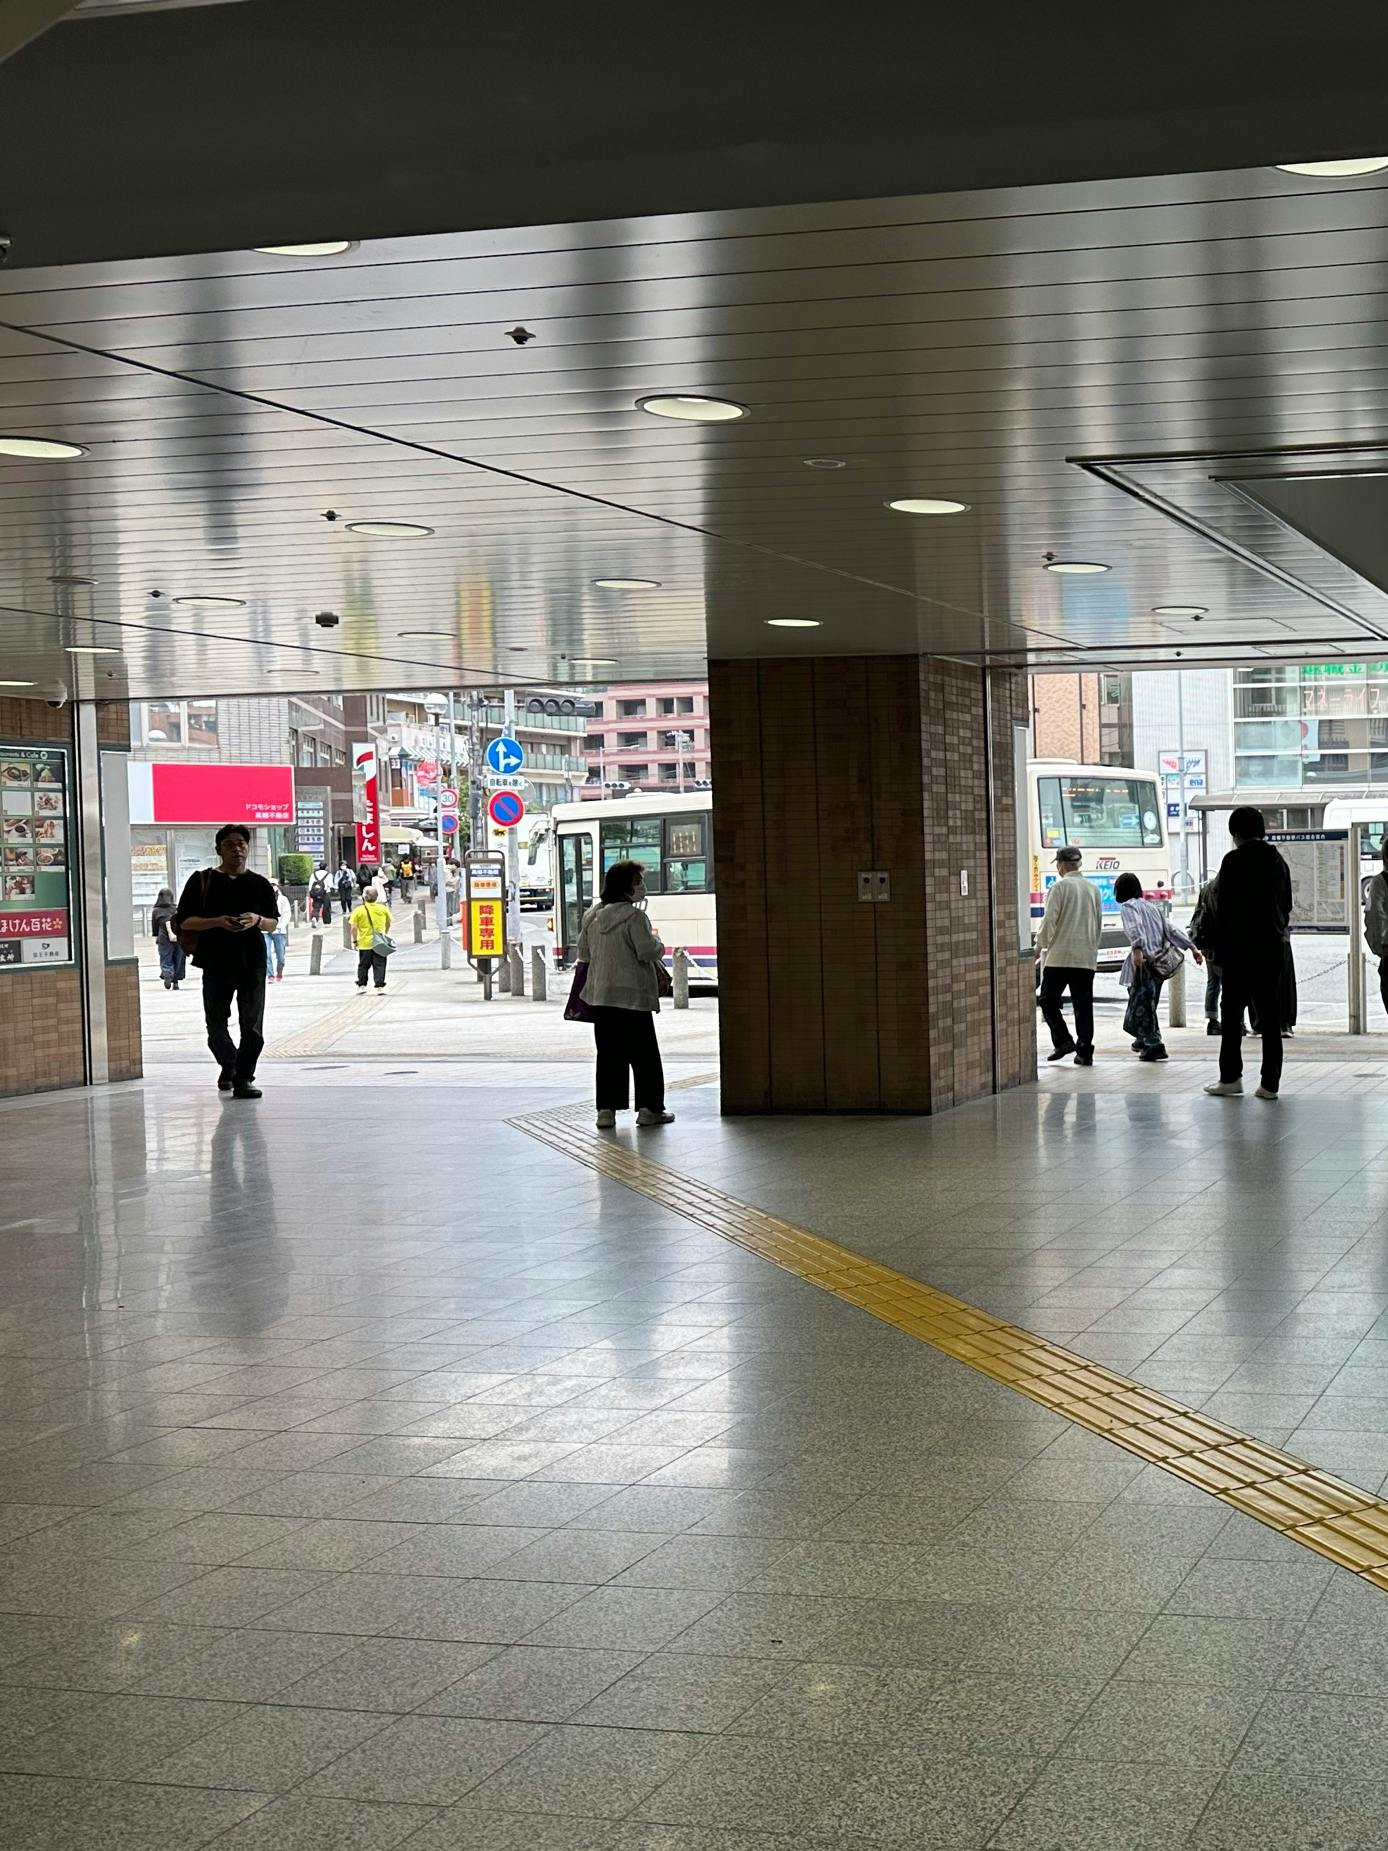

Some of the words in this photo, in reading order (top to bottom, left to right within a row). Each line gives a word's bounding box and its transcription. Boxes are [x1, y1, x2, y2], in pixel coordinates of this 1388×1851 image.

[441, 793, 453, 803] 30
[245, 803, 289, 811] ドコモショップ
[1096, 860, 1120, 870] KEIO
[480, 905, 495, 950] 降車専用
